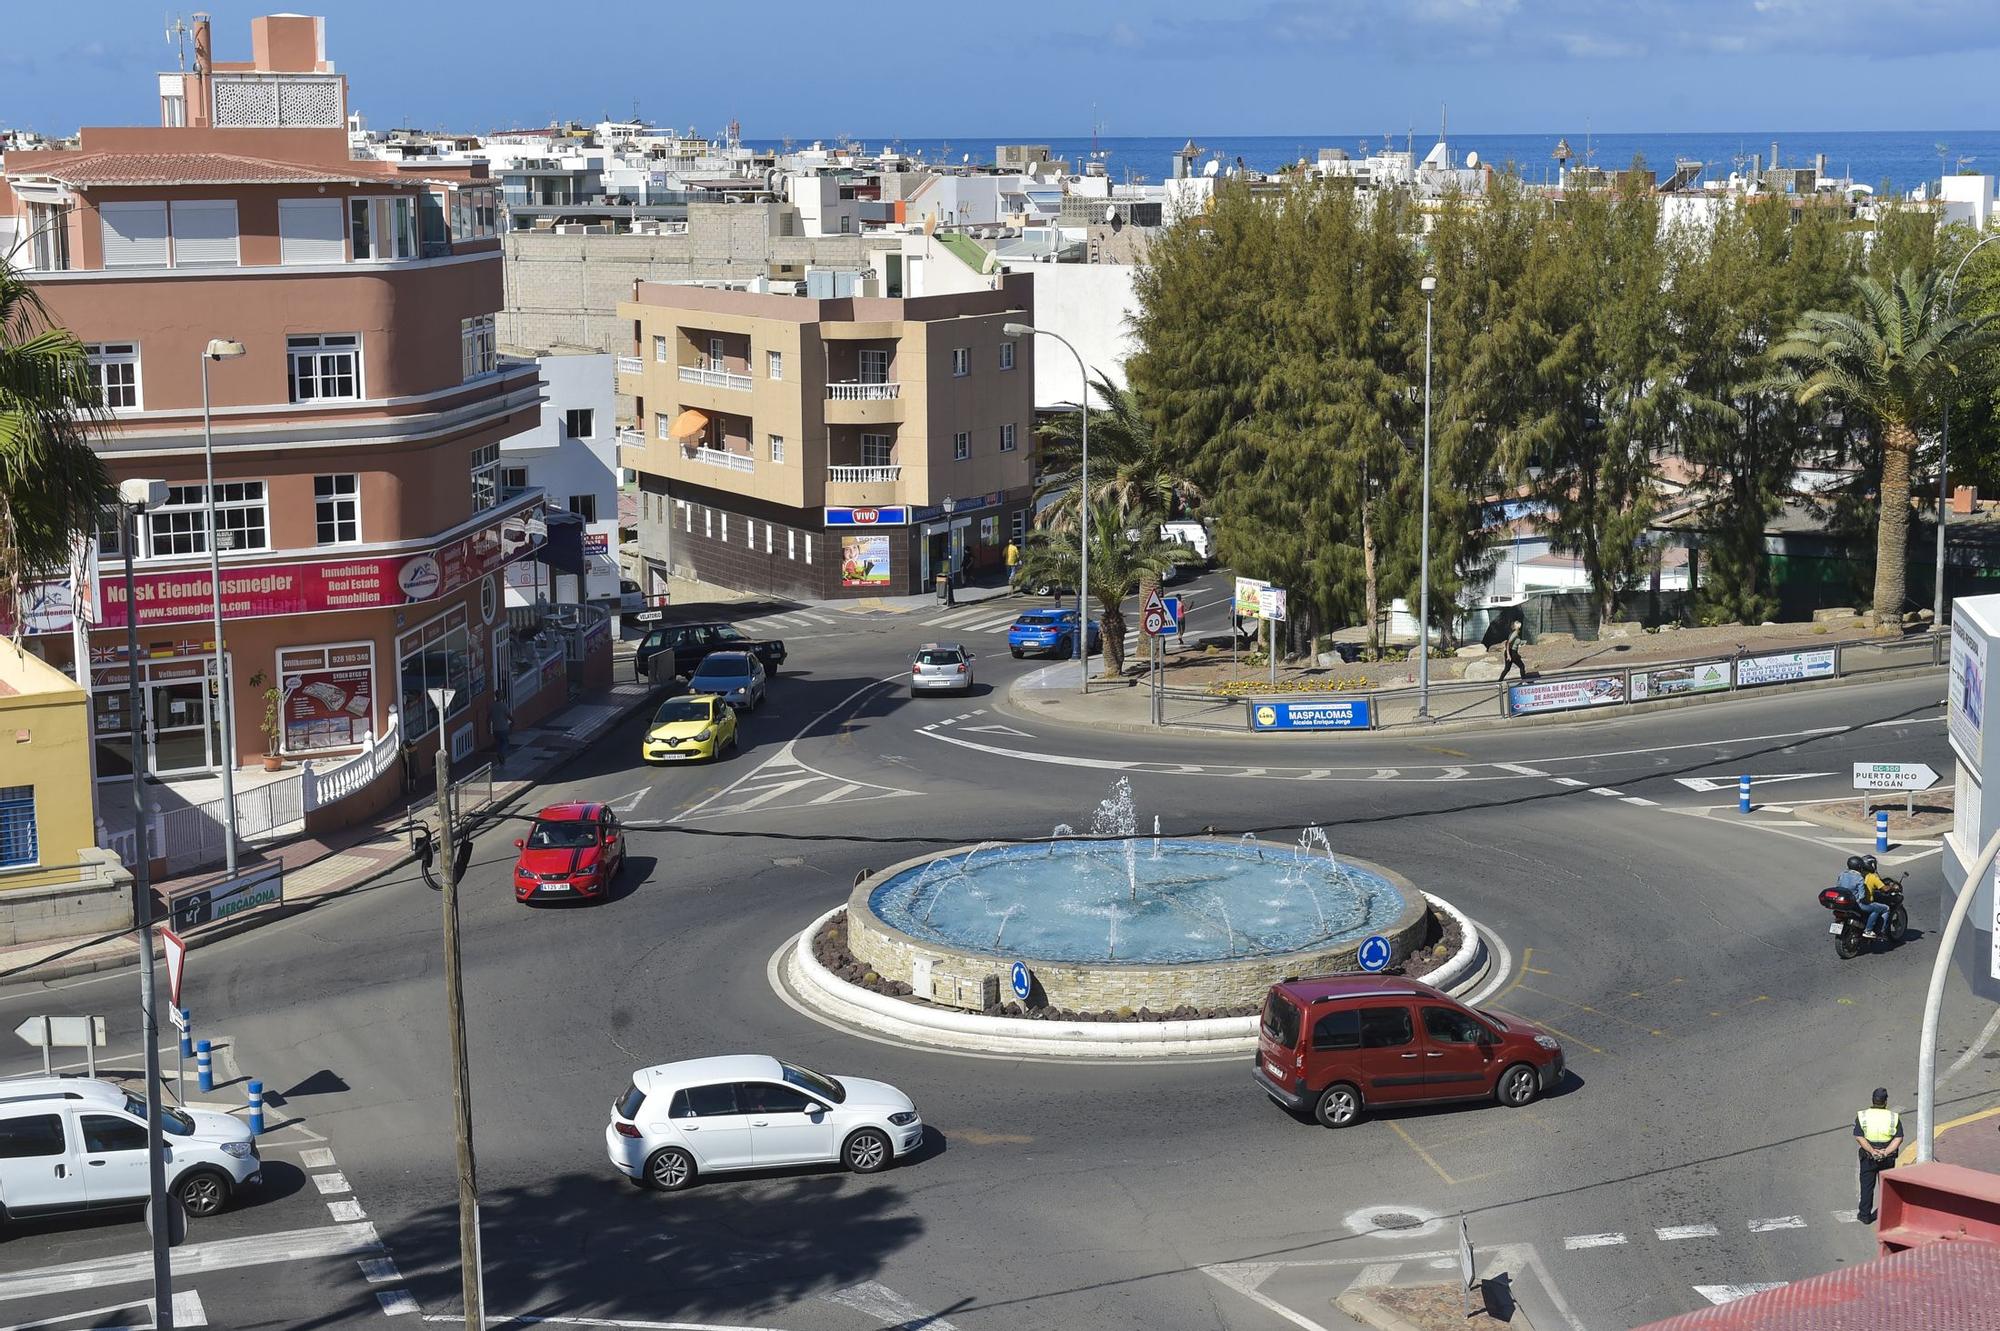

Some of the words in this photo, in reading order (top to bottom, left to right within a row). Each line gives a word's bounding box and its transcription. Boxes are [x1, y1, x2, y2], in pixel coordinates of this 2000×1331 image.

[321, 565, 379, 578] Inmobiliaria
[328, 580, 350, 591] Real
[351, 579, 380, 589] Estate
[107, 583, 155, 602] Nosk
[327, 592, 380, 605] Immobilien
[139, 600, 250, 618] www.semeglern.com
[640, 611, 662, 620] VELATORIO
[1149, 619, 1161, 628] 20
[158, 668, 197, 679] Velkommen
[1552, 683, 1560, 692] DE
[1289, 710, 1353, 720] MASPALOMAS
[1335, 718, 1350, 726] Jorge
[1856, 772, 1891, 780] PUERTO
[217, 888, 275, 917] MERCADONA
